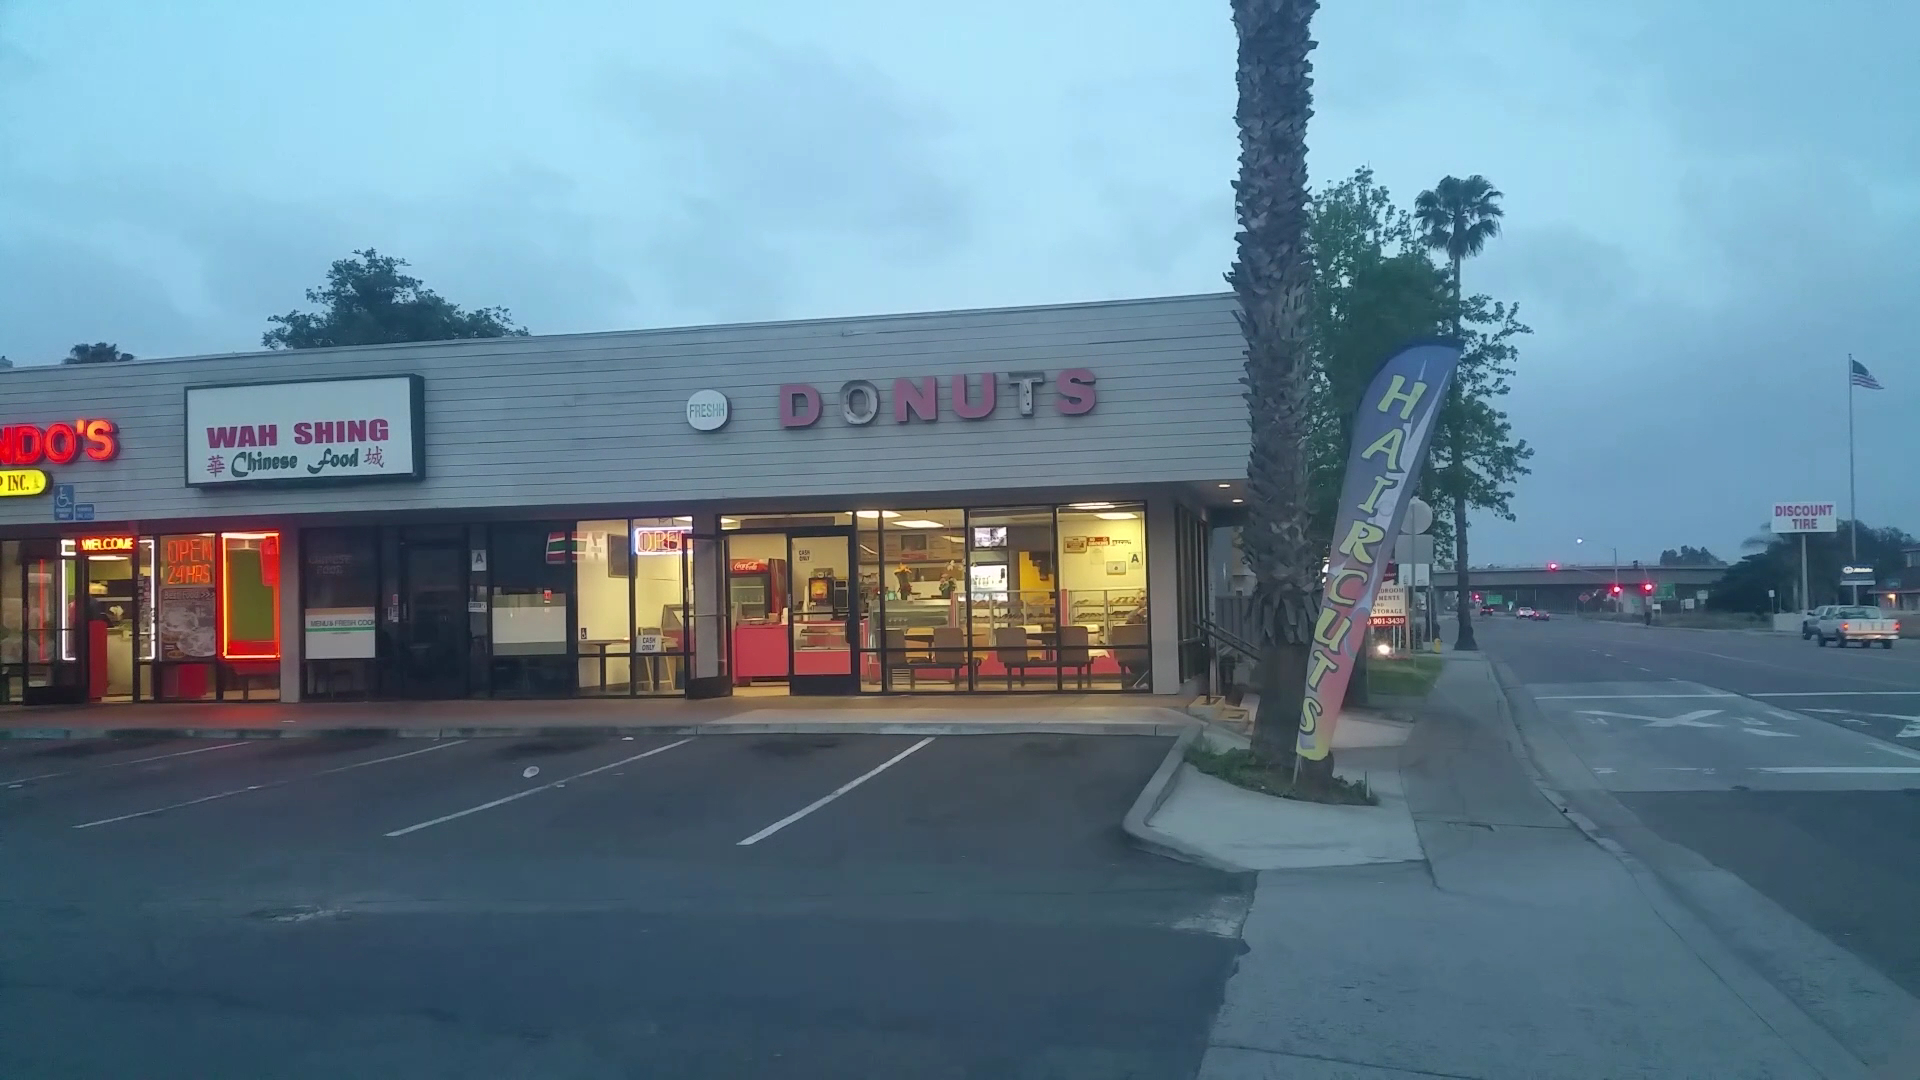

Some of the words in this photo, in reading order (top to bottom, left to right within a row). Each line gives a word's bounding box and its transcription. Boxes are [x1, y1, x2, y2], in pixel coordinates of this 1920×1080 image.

[779, 367, 1097, 428] DONUTS
[689, 403, 725, 418] FRESHH
[207, 424, 277, 448] WAH
[294, 419, 388, 445] SHING
[207, 455, 225, 477] 華
[231, 451, 298, 478] Chinese
[8, 474, 30, 491] INC.
[1775, 504, 1833, 516] DISCOUNT
[1792, 519, 1817, 529] TIRE
[81, 538, 133, 550] WELCOME
[167, 539, 213, 563] OPEN
[638, 530, 684, 552] OPE
[1131, 553, 1140, 563] A
[1299, 374, 1427, 735] HAIRCUTS
